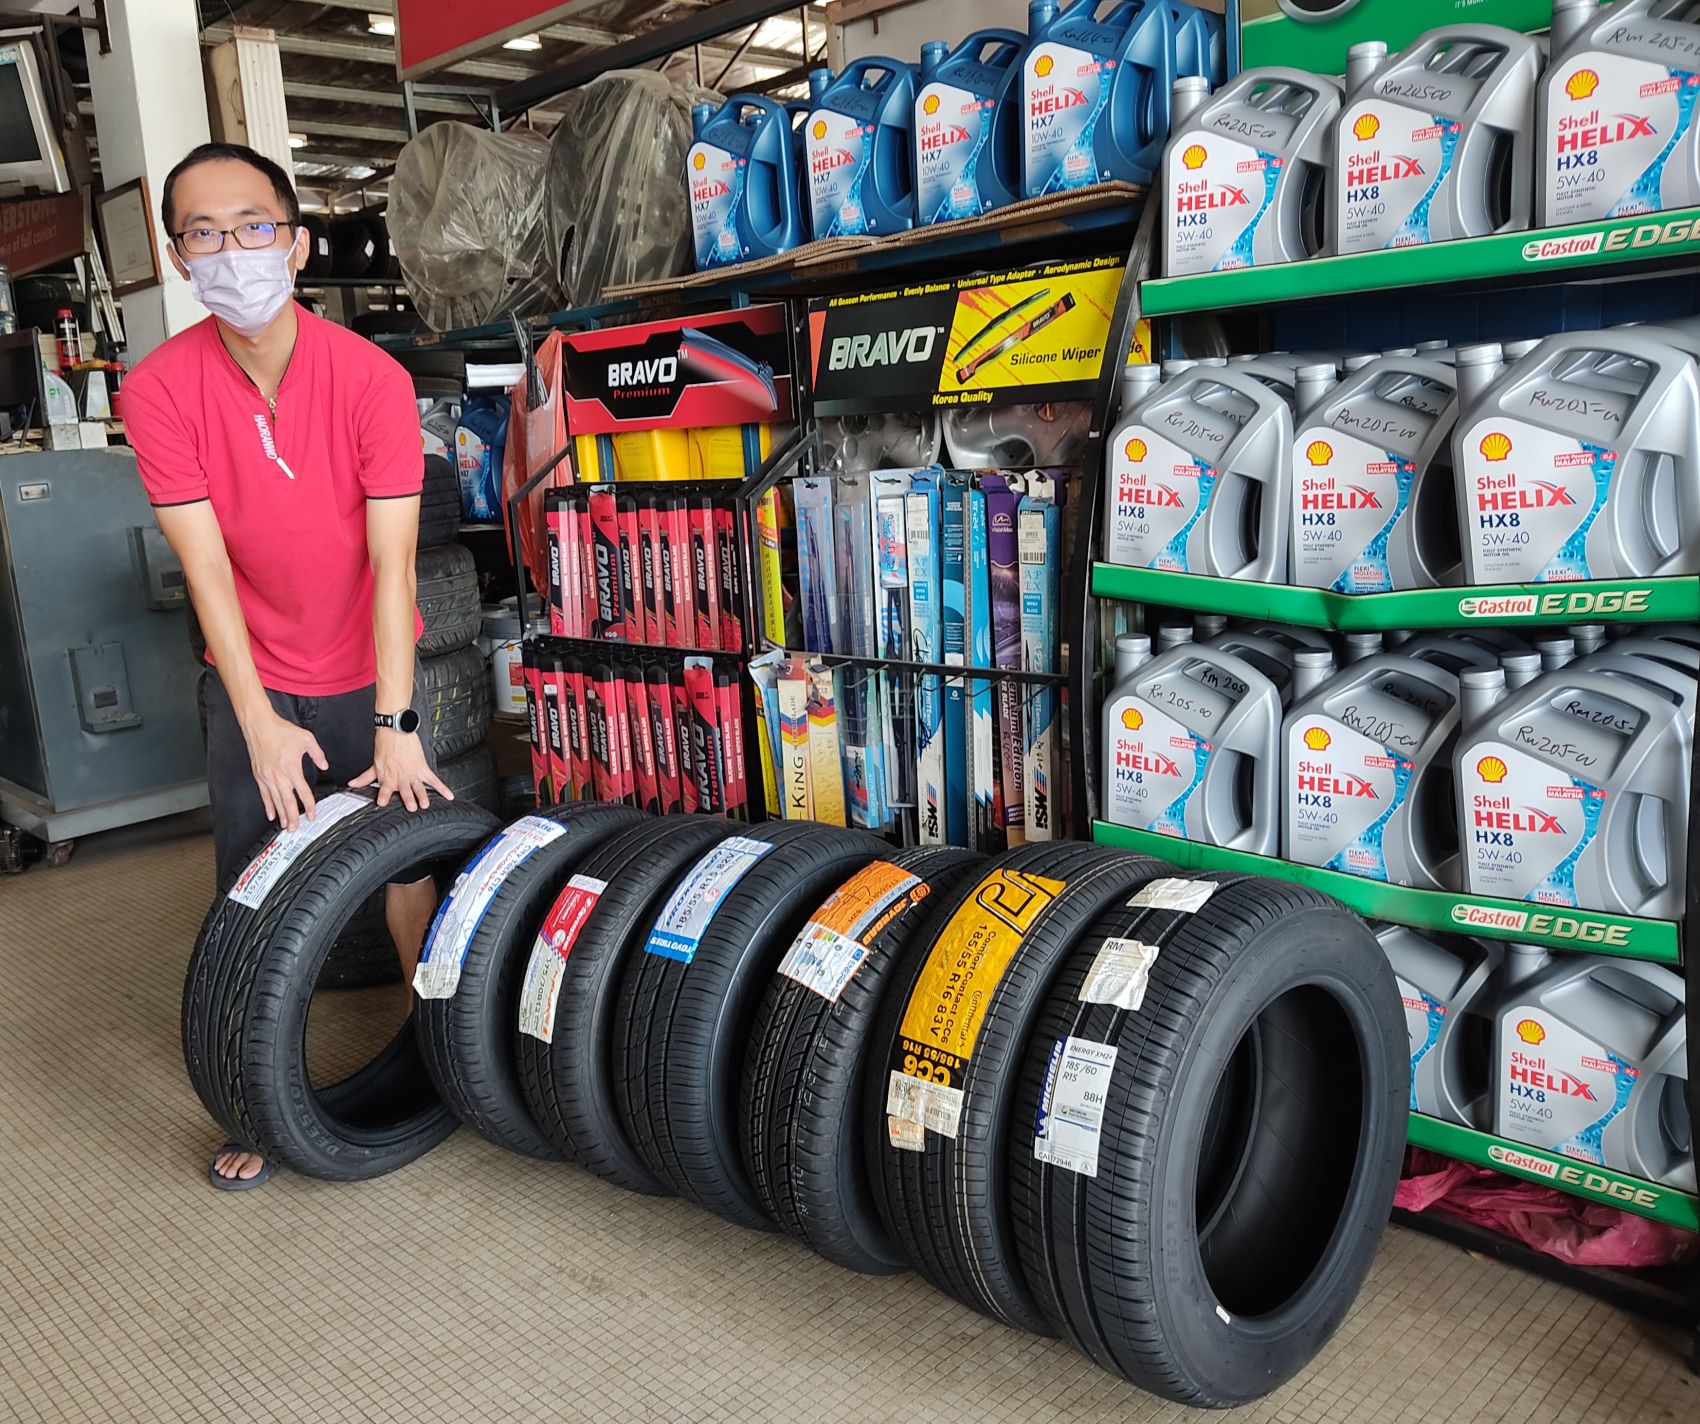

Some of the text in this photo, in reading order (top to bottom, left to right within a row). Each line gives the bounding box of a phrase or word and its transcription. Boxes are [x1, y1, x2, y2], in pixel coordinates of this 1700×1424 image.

[1031, 85, 1055, 100] Shell
[1031, 87, 1089, 117] HELIX
[921, 122, 941, 137] Shell
[1031, 114, 1055, 131] HX7
[1557, 110, 1599, 132] Shell
[921, 124, 972, 151] HELIX
[1031, 128, 1064, 145] 10W-40
[1557, 113, 1658, 154] HELIX
[812, 147, 829, 159] Shell
[812, 149, 856, 174] HELIX
[922, 150, 942, 164] HX7
[1348, 150, 1379, 167] Shell
[1557, 151, 1598, 171] HX8
[813, 172, 830, 185] HX7
[922, 160, 951, 177] 10W-40
[1347, 154, 1425, 187] HELIX
[692, 177, 708, 189] Shell
[1177, 178, 1207, 195] Shell
[1557, 169, 1605, 190] 5W-40
[694, 180, 731, 202] HELIX
[1177, 184, 1249, 212] HELIX
[1347, 186, 1379, 203] HX8
[695, 201, 710, 213] HX7
[1347, 203, 1385, 220] 5W-40
[1177, 213, 1208, 227] HX8
[1177, 228, 1213, 243] 5W-40
[1541, 235, 1599, 258] Castrol
[829, 299, 838, 308] All
[859, 290, 897, 303] Performance
[904, 285, 924, 297] Evenly
[925, 282, 950, 294] Balance
[957, 275, 988, 289] Universal
[990, 273, 1006, 285] Type
[1006, 268, 1037, 282] Adapter
[1043, 260, 1092, 276] Aerodynamic
[1093, 256, 1121, 269] Design
[828, 326, 936, 371] BRAVO
[1010, 346, 1101, 367] Silicone Wiper
[608, 356, 678, 387] BRAVO
[613, 387, 670, 400] Premium
[932, 390, 993, 405] Korea Quality
[1554, 458, 1594, 467] MALAYSIA
[1119, 474, 1147, 485] Shell
[1303, 477, 1335, 490] Shell
[1478, 474, 1516, 490] Shell
[1119, 482, 1185, 508] HELIX
[1302, 484, 1382, 510] HELIX
[1477, 480, 1577, 511] HELIX
[1118, 505, 1145, 518] HX8
[1302, 513, 1336, 525] HX8
[1480, 512, 1520, 528] HX8
[1118, 520, 1150, 535] 5W-40
[1302, 530, 1342, 542] 5W-40
[1481, 531, 1530, 546] 5W-40
[551, 546, 561, 587] BRAVO
[623, 549, 632, 591] BRAVO
[645, 547, 655, 590] BRAVO
[662, 550, 672, 592] BRAVO
[696, 548, 706, 591] BRAVO
[596, 543, 612, 622] BRAVO
[610, 553, 622, 617] Premium
[1477, 589, 1653, 616] Castrol EDGE
[1001, 697, 1010, 720] BLADE
[529, 703, 538, 743] BRAVO
[549, 707, 560, 749] BRAVO
[570, 708, 579, 749] BRAVO
[599, 719, 609, 763] BRAVO
[655, 721, 666, 766] BRAVO
[681, 725, 691, 770] BRAVO
[1117, 739, 1143, 753] Shell
[707, 735, 719, 807] Premium
[1010, 735, 1025, 792] Edition
[1116, 751, 1182, 778] HELIX
[1298, 761, 1331, 774] Shell
[792, 756, 806, 809] KiNG
[1116, 767, 1143, 783] HX8
[1298, 771, 1379, 799] HELIX
[1115, 782, 1148, 798] 5W-40
[1298, 793, 1332, 808] HX8
[1547, 791, 1584, 799] MALAYSIA
[1474, 795, 1510, 810] Shell
[1298, 808, 1338, 824] 5W-40
[1474, 805, 1566, 835] HELIX
[1476, 831, 1514, 847] HX8
[1477, 847, 1522, 864] 5W-40
[664, 871, 703, 927] PROXES
[676, 892, 702, 930] 185/55
[699, 870, 719, 890] R15
[862, 897, 908, 947] JOYROAD
[1469, 906, 1634, 947] Castrol EDGE
[651, 936, 693, 954] TOYO TIRES
[1106, 941, 1124, 951] RM
[930, 924, 988, 1038] 185/55 R16 83V
[940, 930, 998, 1045] Comfort Contact CC6
[902, 1039, 961, 1070] 185/55 R16
[1069, 1044, 1095, 1057] ENERGY
[1510, 1052, 1545, 1070] Shell
[903, 1058, 952, 1087] CC6
[1042, 1040, 1063, 1112] MICHELIN
[1062, 1072, 1078, 1083] R15
[1510, 1065, 1597, 1102] HELIX
[1510, 1082, 1546, 1102] HX8
[1083, 1090, 1104, 1106] 88H
[1510, 1100, 1553, 1120] 5W-40
[1504, 1151, 1660, 1209] Castrol EDGE
